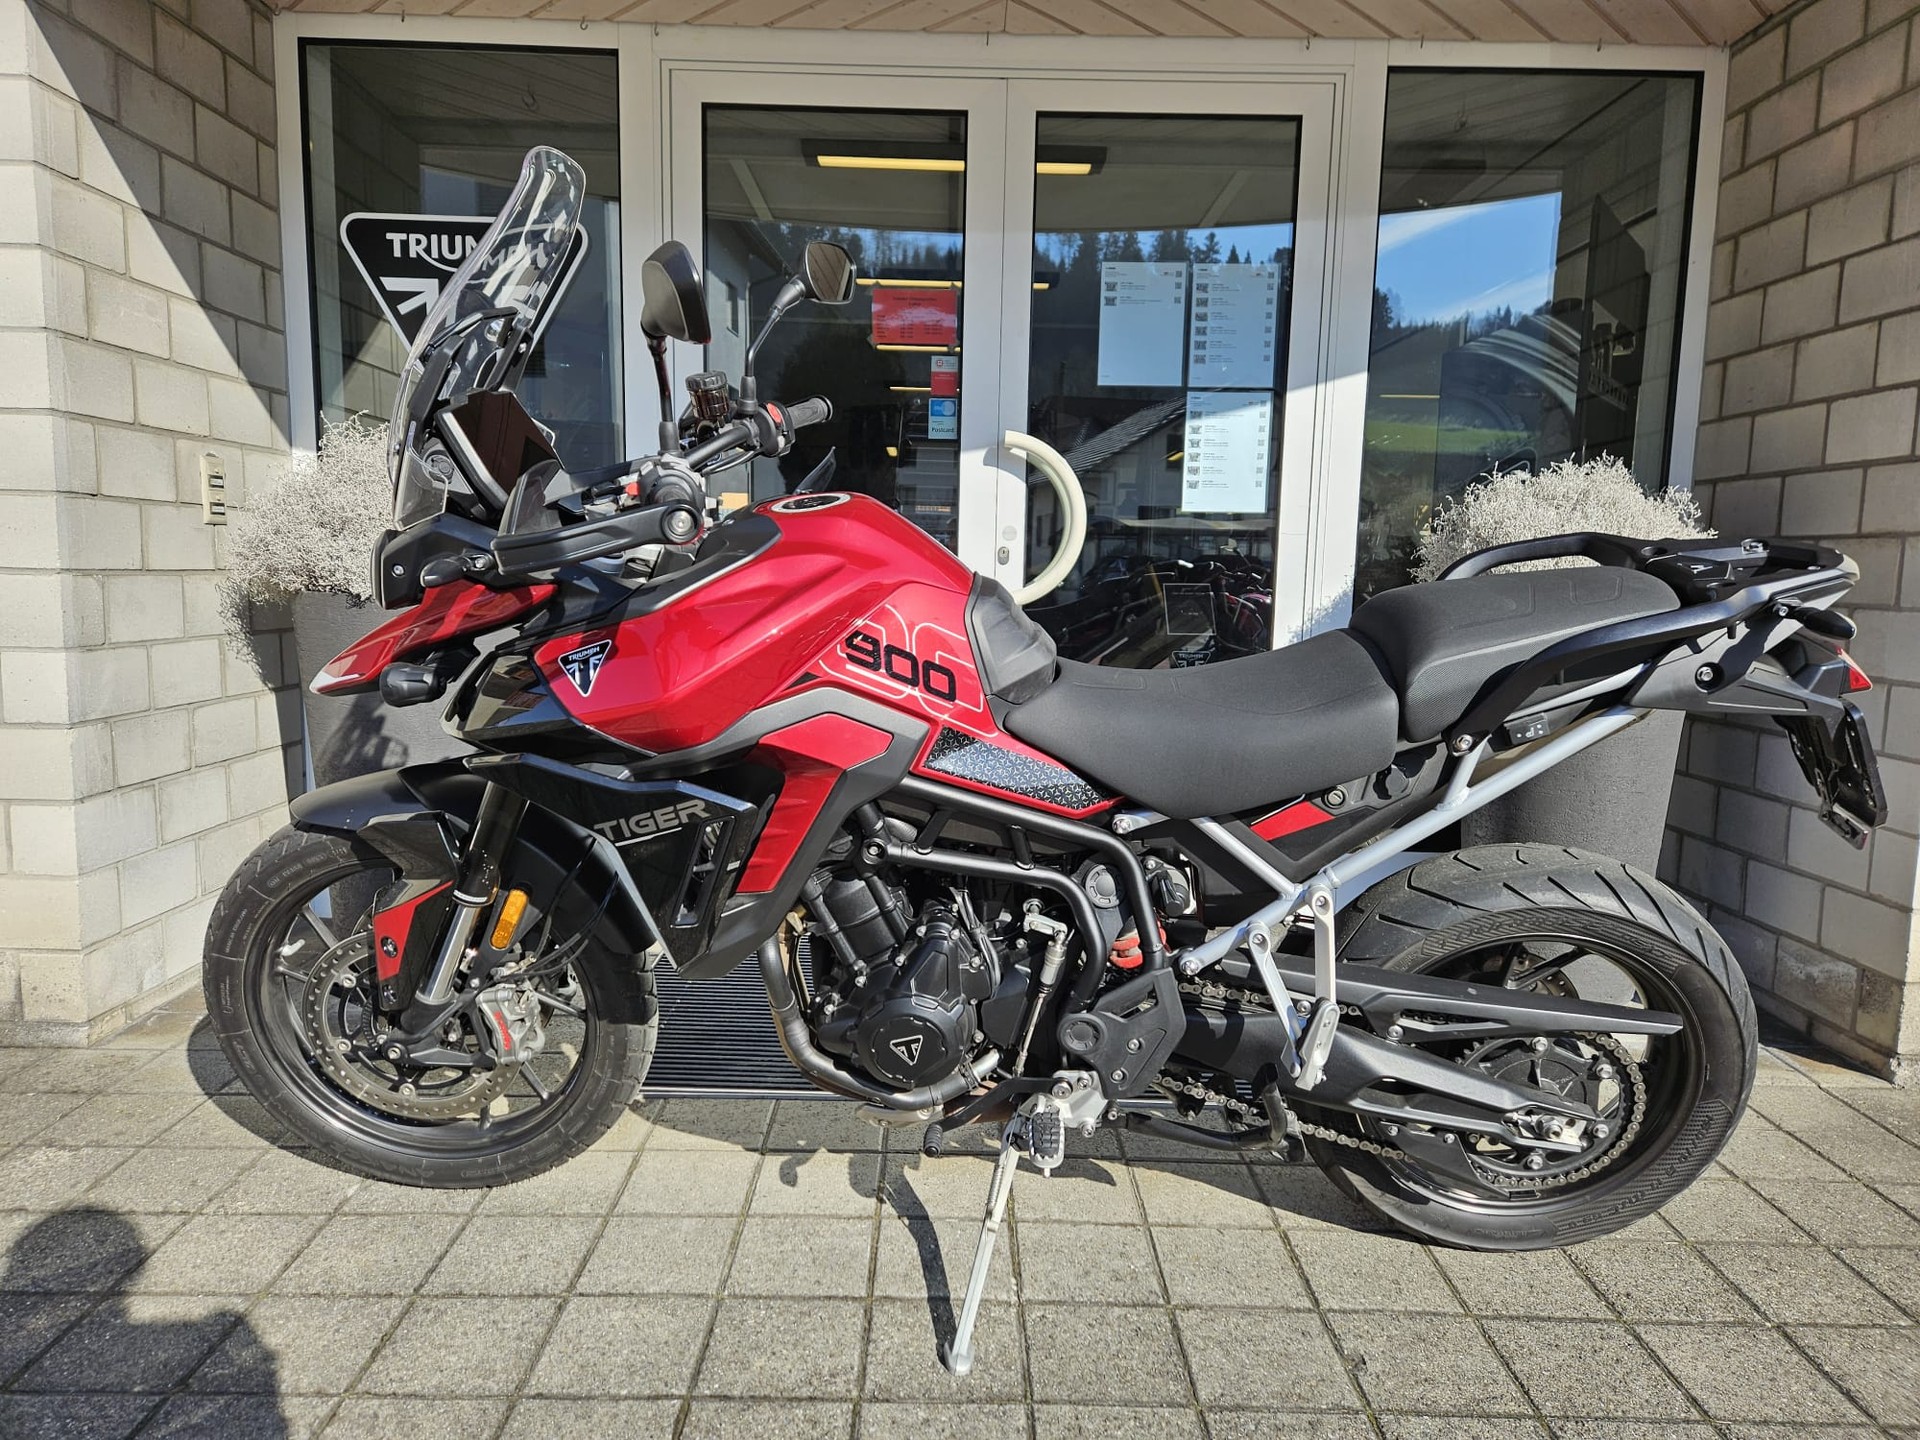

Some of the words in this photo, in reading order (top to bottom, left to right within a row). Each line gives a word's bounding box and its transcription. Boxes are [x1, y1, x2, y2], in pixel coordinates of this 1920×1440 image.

[568, 646, 600, 661] TRIUMPH
[845, 630, 957, 702] 900
[593, 799, 712, 841] TIGER
